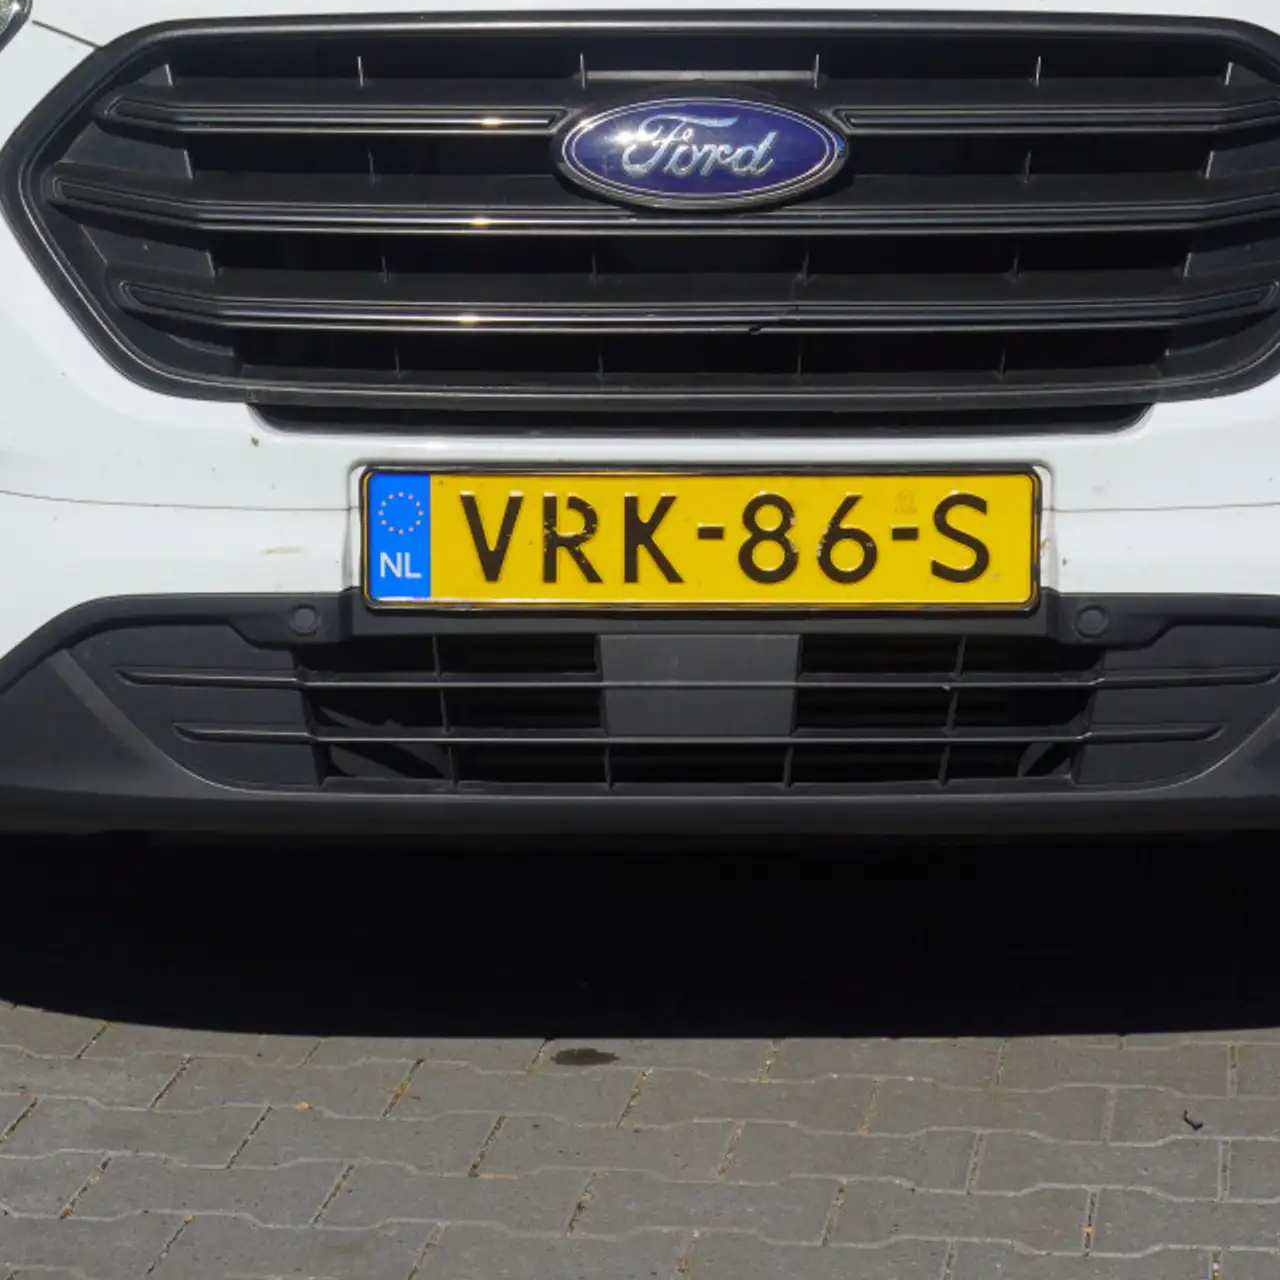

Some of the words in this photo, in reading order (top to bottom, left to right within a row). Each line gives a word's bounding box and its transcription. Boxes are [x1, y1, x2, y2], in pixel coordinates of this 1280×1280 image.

[622, 113, 778, 178] Ford
[379, 551, 423, 579] NL
[458, 493, 991, 585] VRK-86-S
